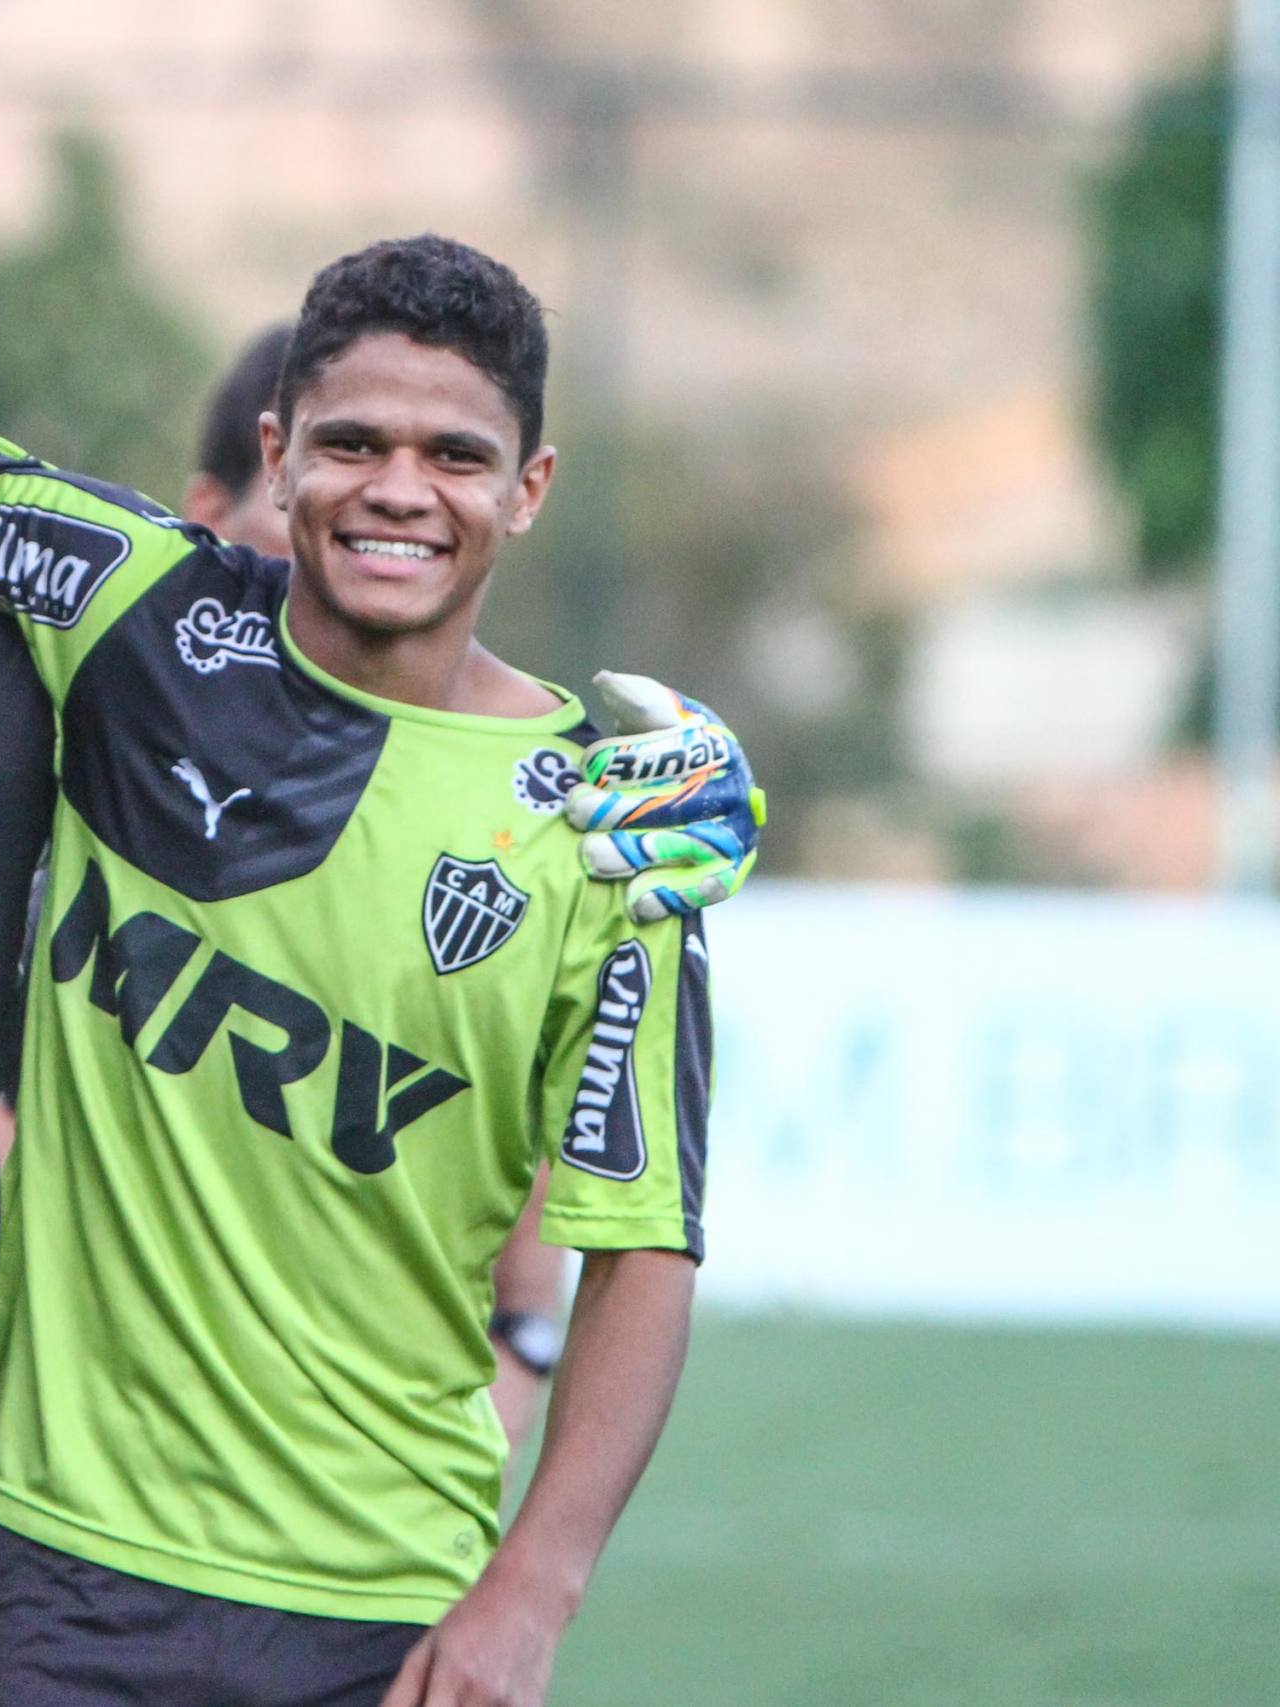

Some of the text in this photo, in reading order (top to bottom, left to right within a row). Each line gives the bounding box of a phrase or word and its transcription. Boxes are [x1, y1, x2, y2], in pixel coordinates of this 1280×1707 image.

[188, 599, 275, 651] Cem
[534, 750, 583, 794] Ce
[447, 868, 517, 916] CAM
[51, 856, 472, 1174] MRV
[571, 955, 641, 1153] Vilma
